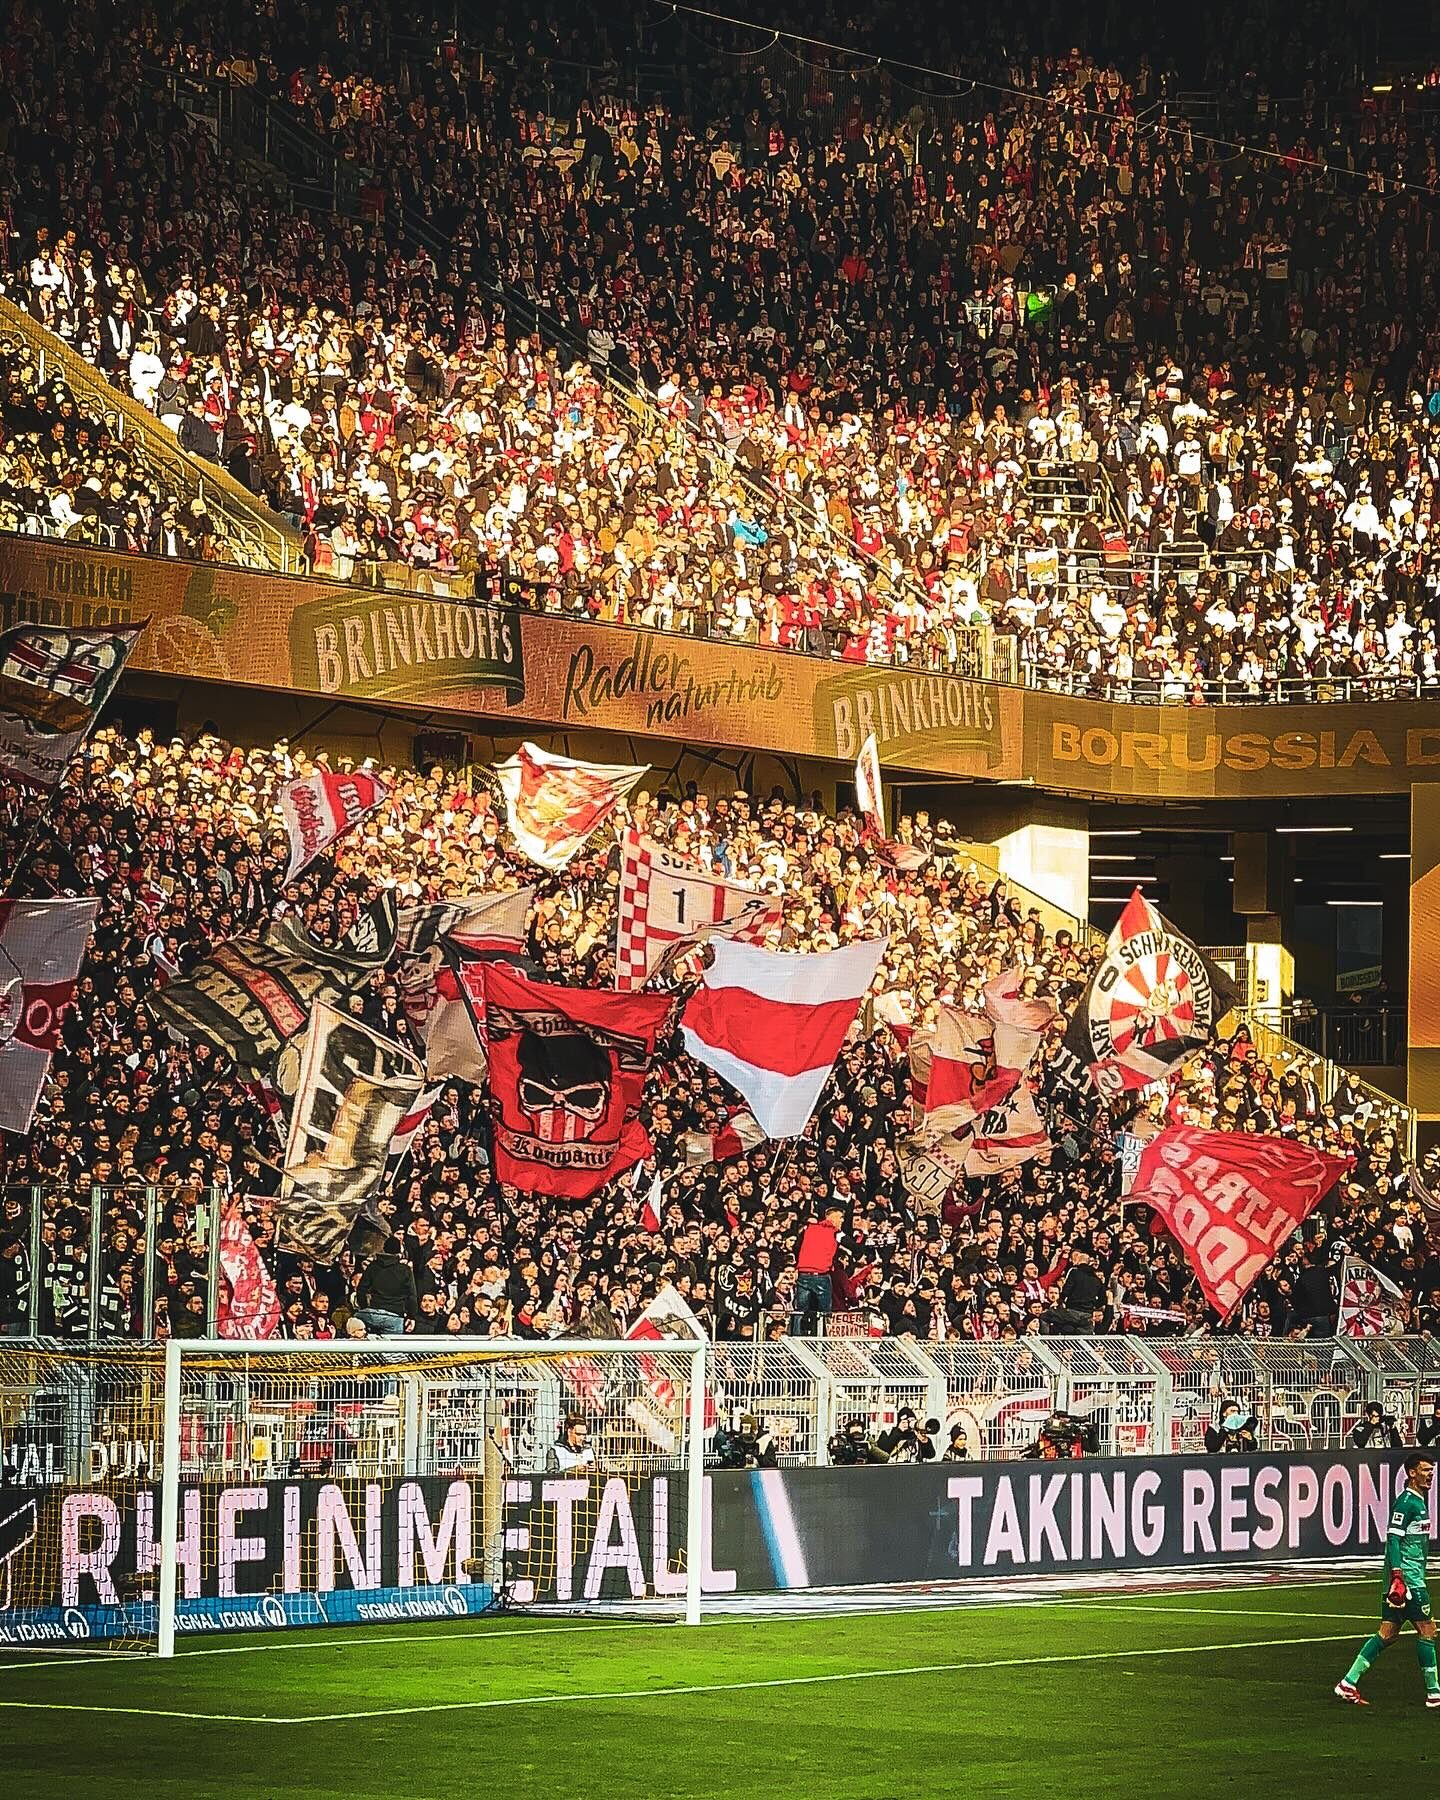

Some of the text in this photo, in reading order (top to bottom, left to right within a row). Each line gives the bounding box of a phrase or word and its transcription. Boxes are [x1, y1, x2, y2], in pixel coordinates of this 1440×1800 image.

[563, 633, 689, 719] Radler
[1052, 722, 1391, 771] BORUSSIA
[61, 1476, 737, 1606] RHEINMETALL
[947, 1470, 1165, 1567] TAKING
[218, 1610, 266, 1629] IDUNA
[357, 1599, 449, 1619] SIGNAL IDUNA
